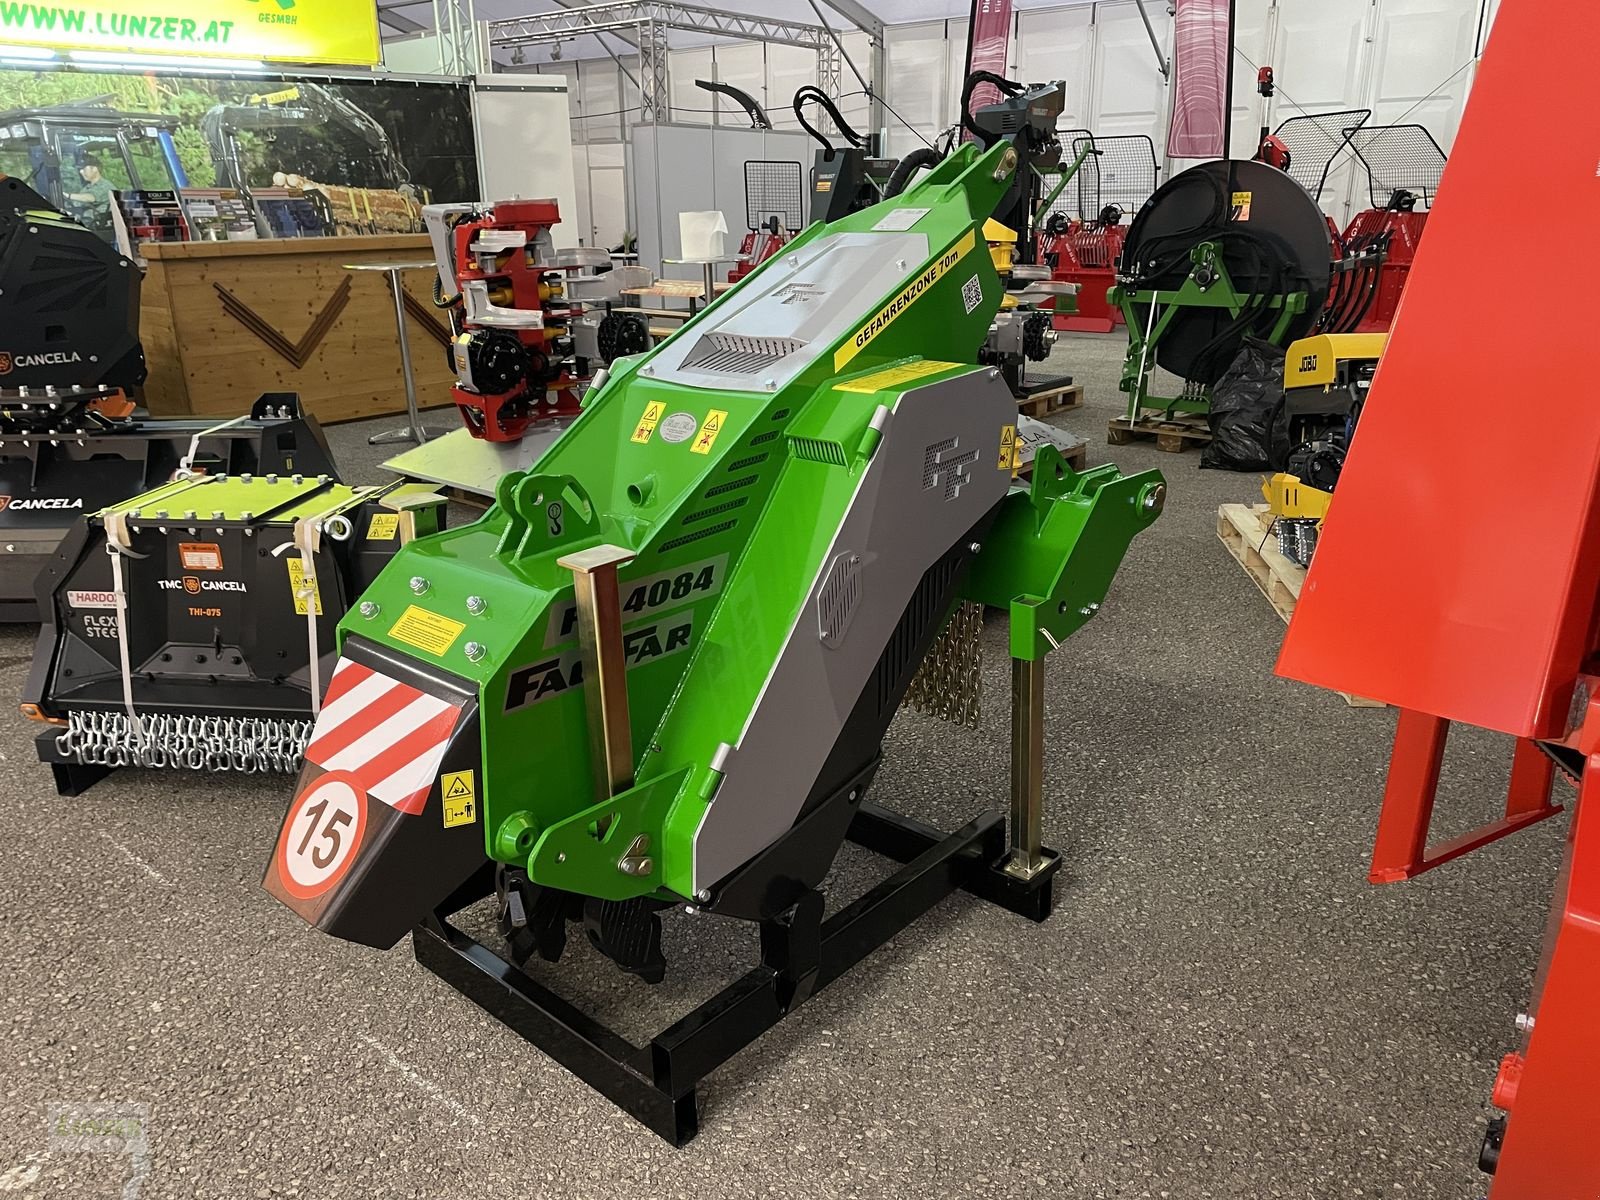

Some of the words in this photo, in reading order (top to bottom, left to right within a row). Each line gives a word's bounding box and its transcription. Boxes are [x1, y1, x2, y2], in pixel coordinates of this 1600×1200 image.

[0, 1, 234, 44] WWW.LUNZER.AT
[258, 12, 298, 25] GESMBH
[855, 266, 938, 348] GEFAHRENZONE
[938, 250, 959, 273] 70m
[13, 351, 82, 367] CANCELA
[1298, 354, 1318, 373] JOBO
[8, 498, 83, 510] CANCELA
[157, 579, 183, 590] TMC
[200, 580, 248, 593] CANCELA
[623, 564, 715, 613] 4084
[76, 592, 117, 603] HARDO
[188, 607, 222, 617] THI-075
[296, 798, 354, 870] 15
